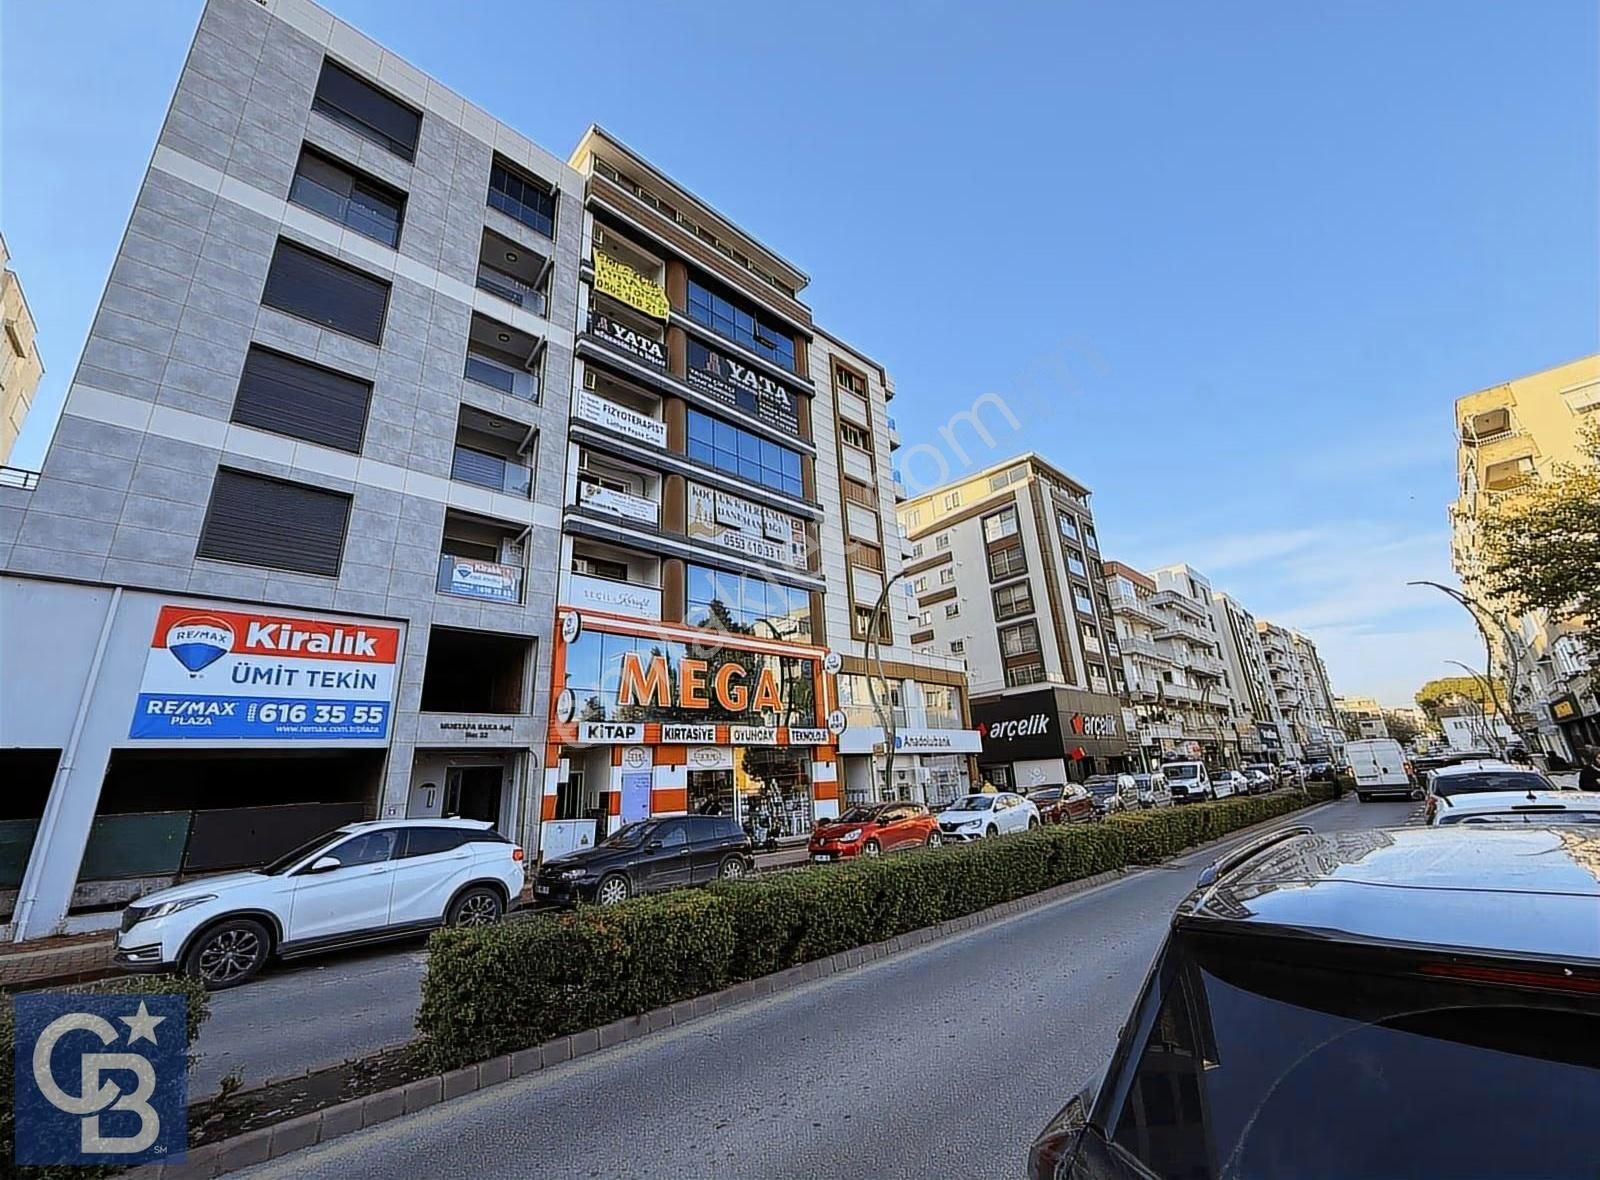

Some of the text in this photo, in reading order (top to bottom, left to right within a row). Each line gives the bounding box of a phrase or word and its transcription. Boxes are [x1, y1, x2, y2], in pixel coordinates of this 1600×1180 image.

[611, 322, 664, 359] YATA
[726, 359, 792, 406] YATA
[176, 630, 228, 643] RE/MAX
[246, 621, 377, 657] Kiralık
[231, 661, 376, 690] ÜMİT TEKİN
[616, 651, 785, 715] MEGA
[147, 700, 236, 716] RE/MAX
[170, 716, 213, 726] PLAZA
[259, 703, 307, 723] 616
[313, 705, 346, 723] 35
[352, 706, 383, 724] 55
[588, 724, 636, 739] KİTAP
[664, 726, 713, 740] KIRTASİYE
[989, 713, 1050, 742] arçelik
[1084, 713, 1118, 741] arçelik
